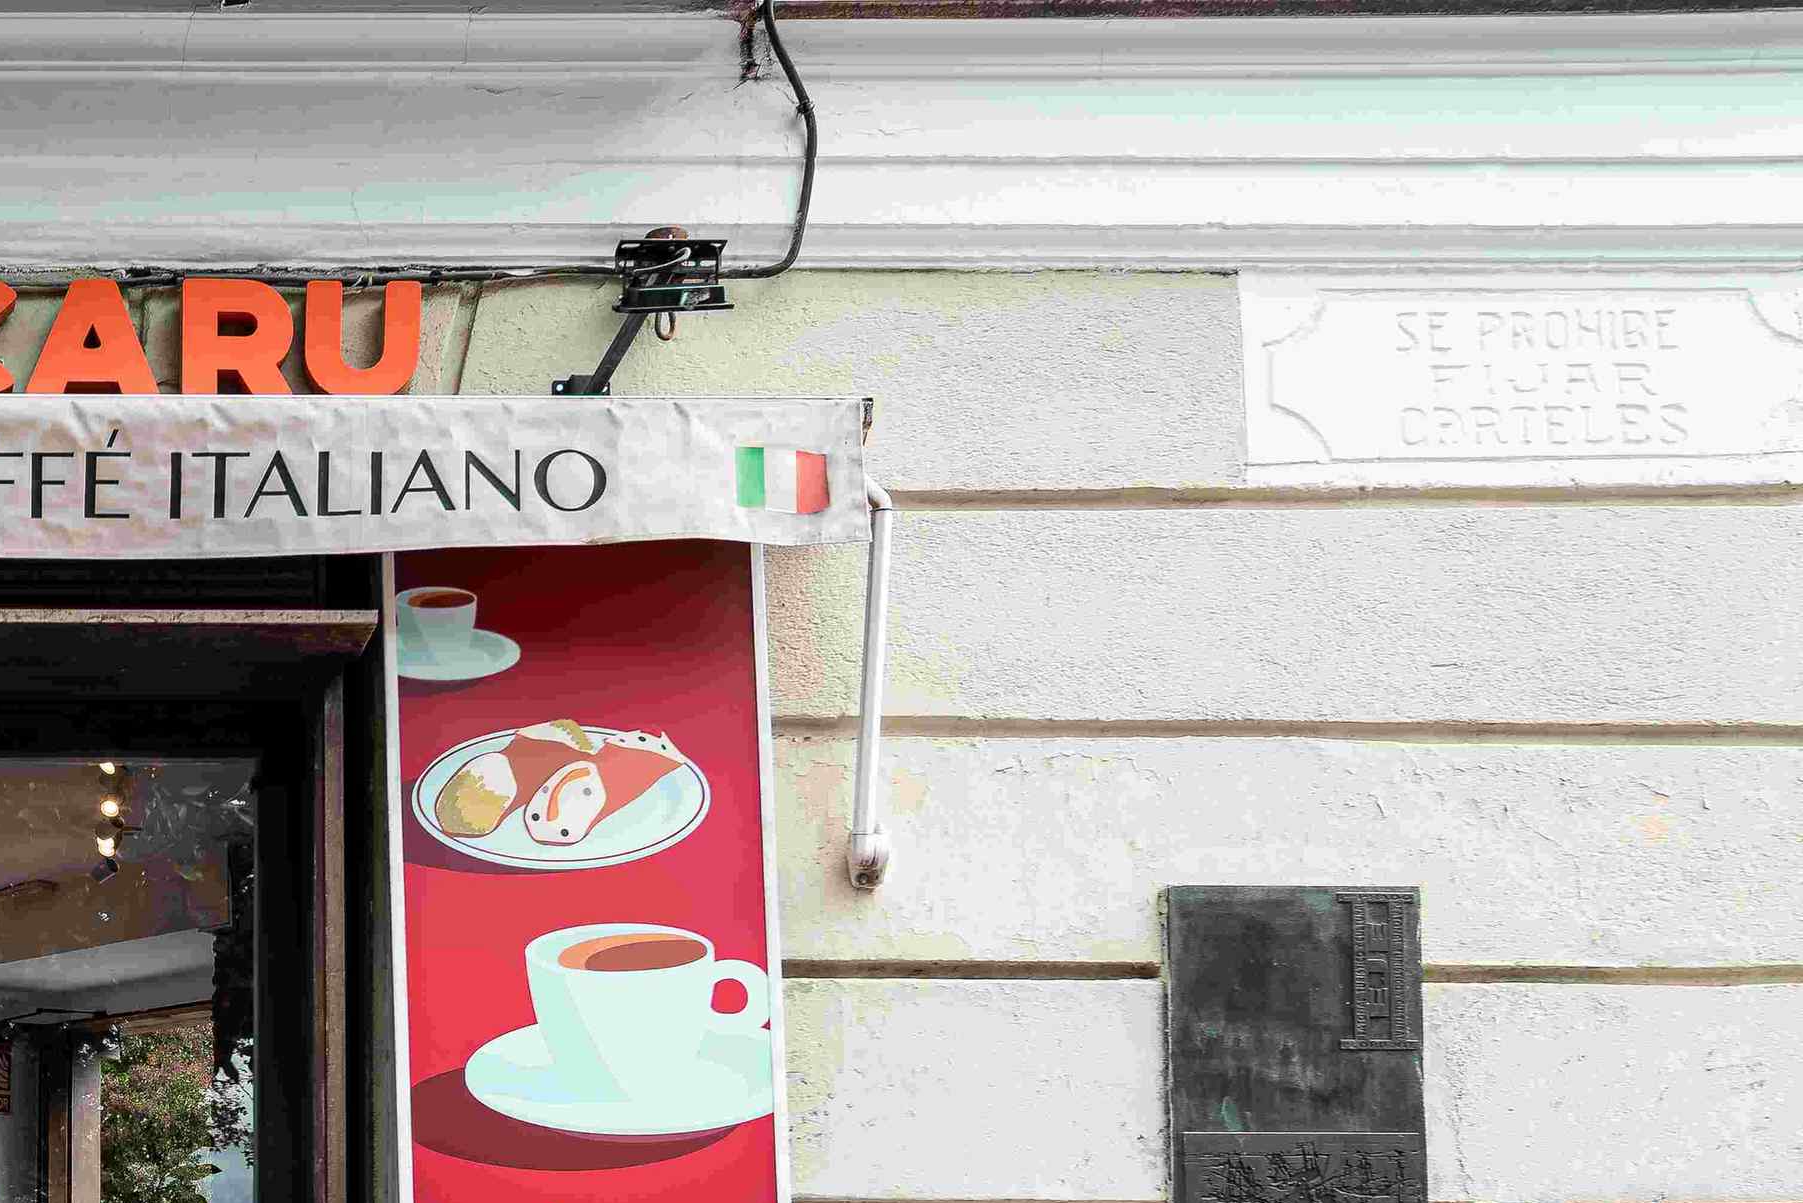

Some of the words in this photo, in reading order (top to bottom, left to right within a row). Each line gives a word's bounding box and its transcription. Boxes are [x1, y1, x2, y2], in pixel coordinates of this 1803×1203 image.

[1396, 310, 1453, 352] SE
[1477, 308, 1680, 352] PROHIBE
[1430, 362, 1658, 397] FIJAR
[1400, 402, 1689, 446] CARTELES
[169, 447, 608, 520] ITALIANO
